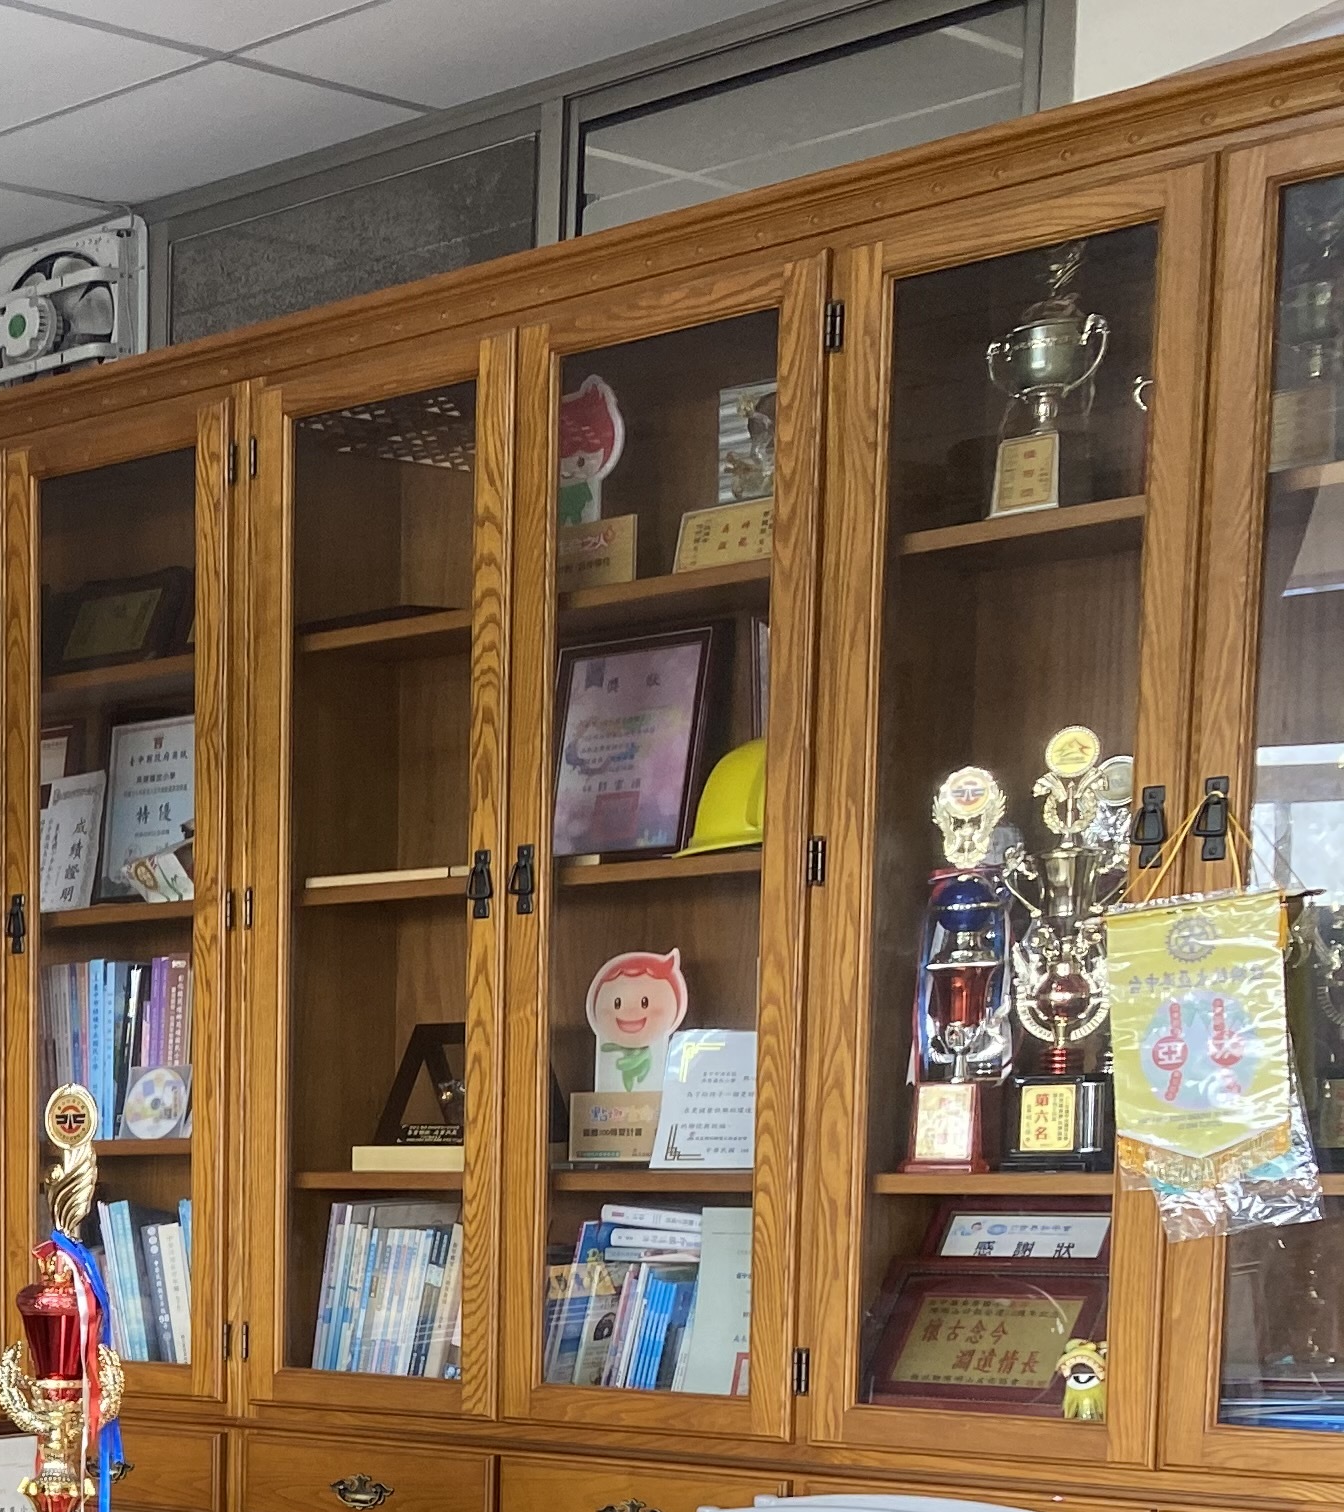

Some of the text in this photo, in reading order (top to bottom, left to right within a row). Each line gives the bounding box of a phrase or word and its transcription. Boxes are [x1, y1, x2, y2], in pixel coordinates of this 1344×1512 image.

[60, 817, 88, 902] 成績證明
[1034, 1093, 1050, 1141] 第六名
[921, 1317, 1009, 1345] 懷古念今
